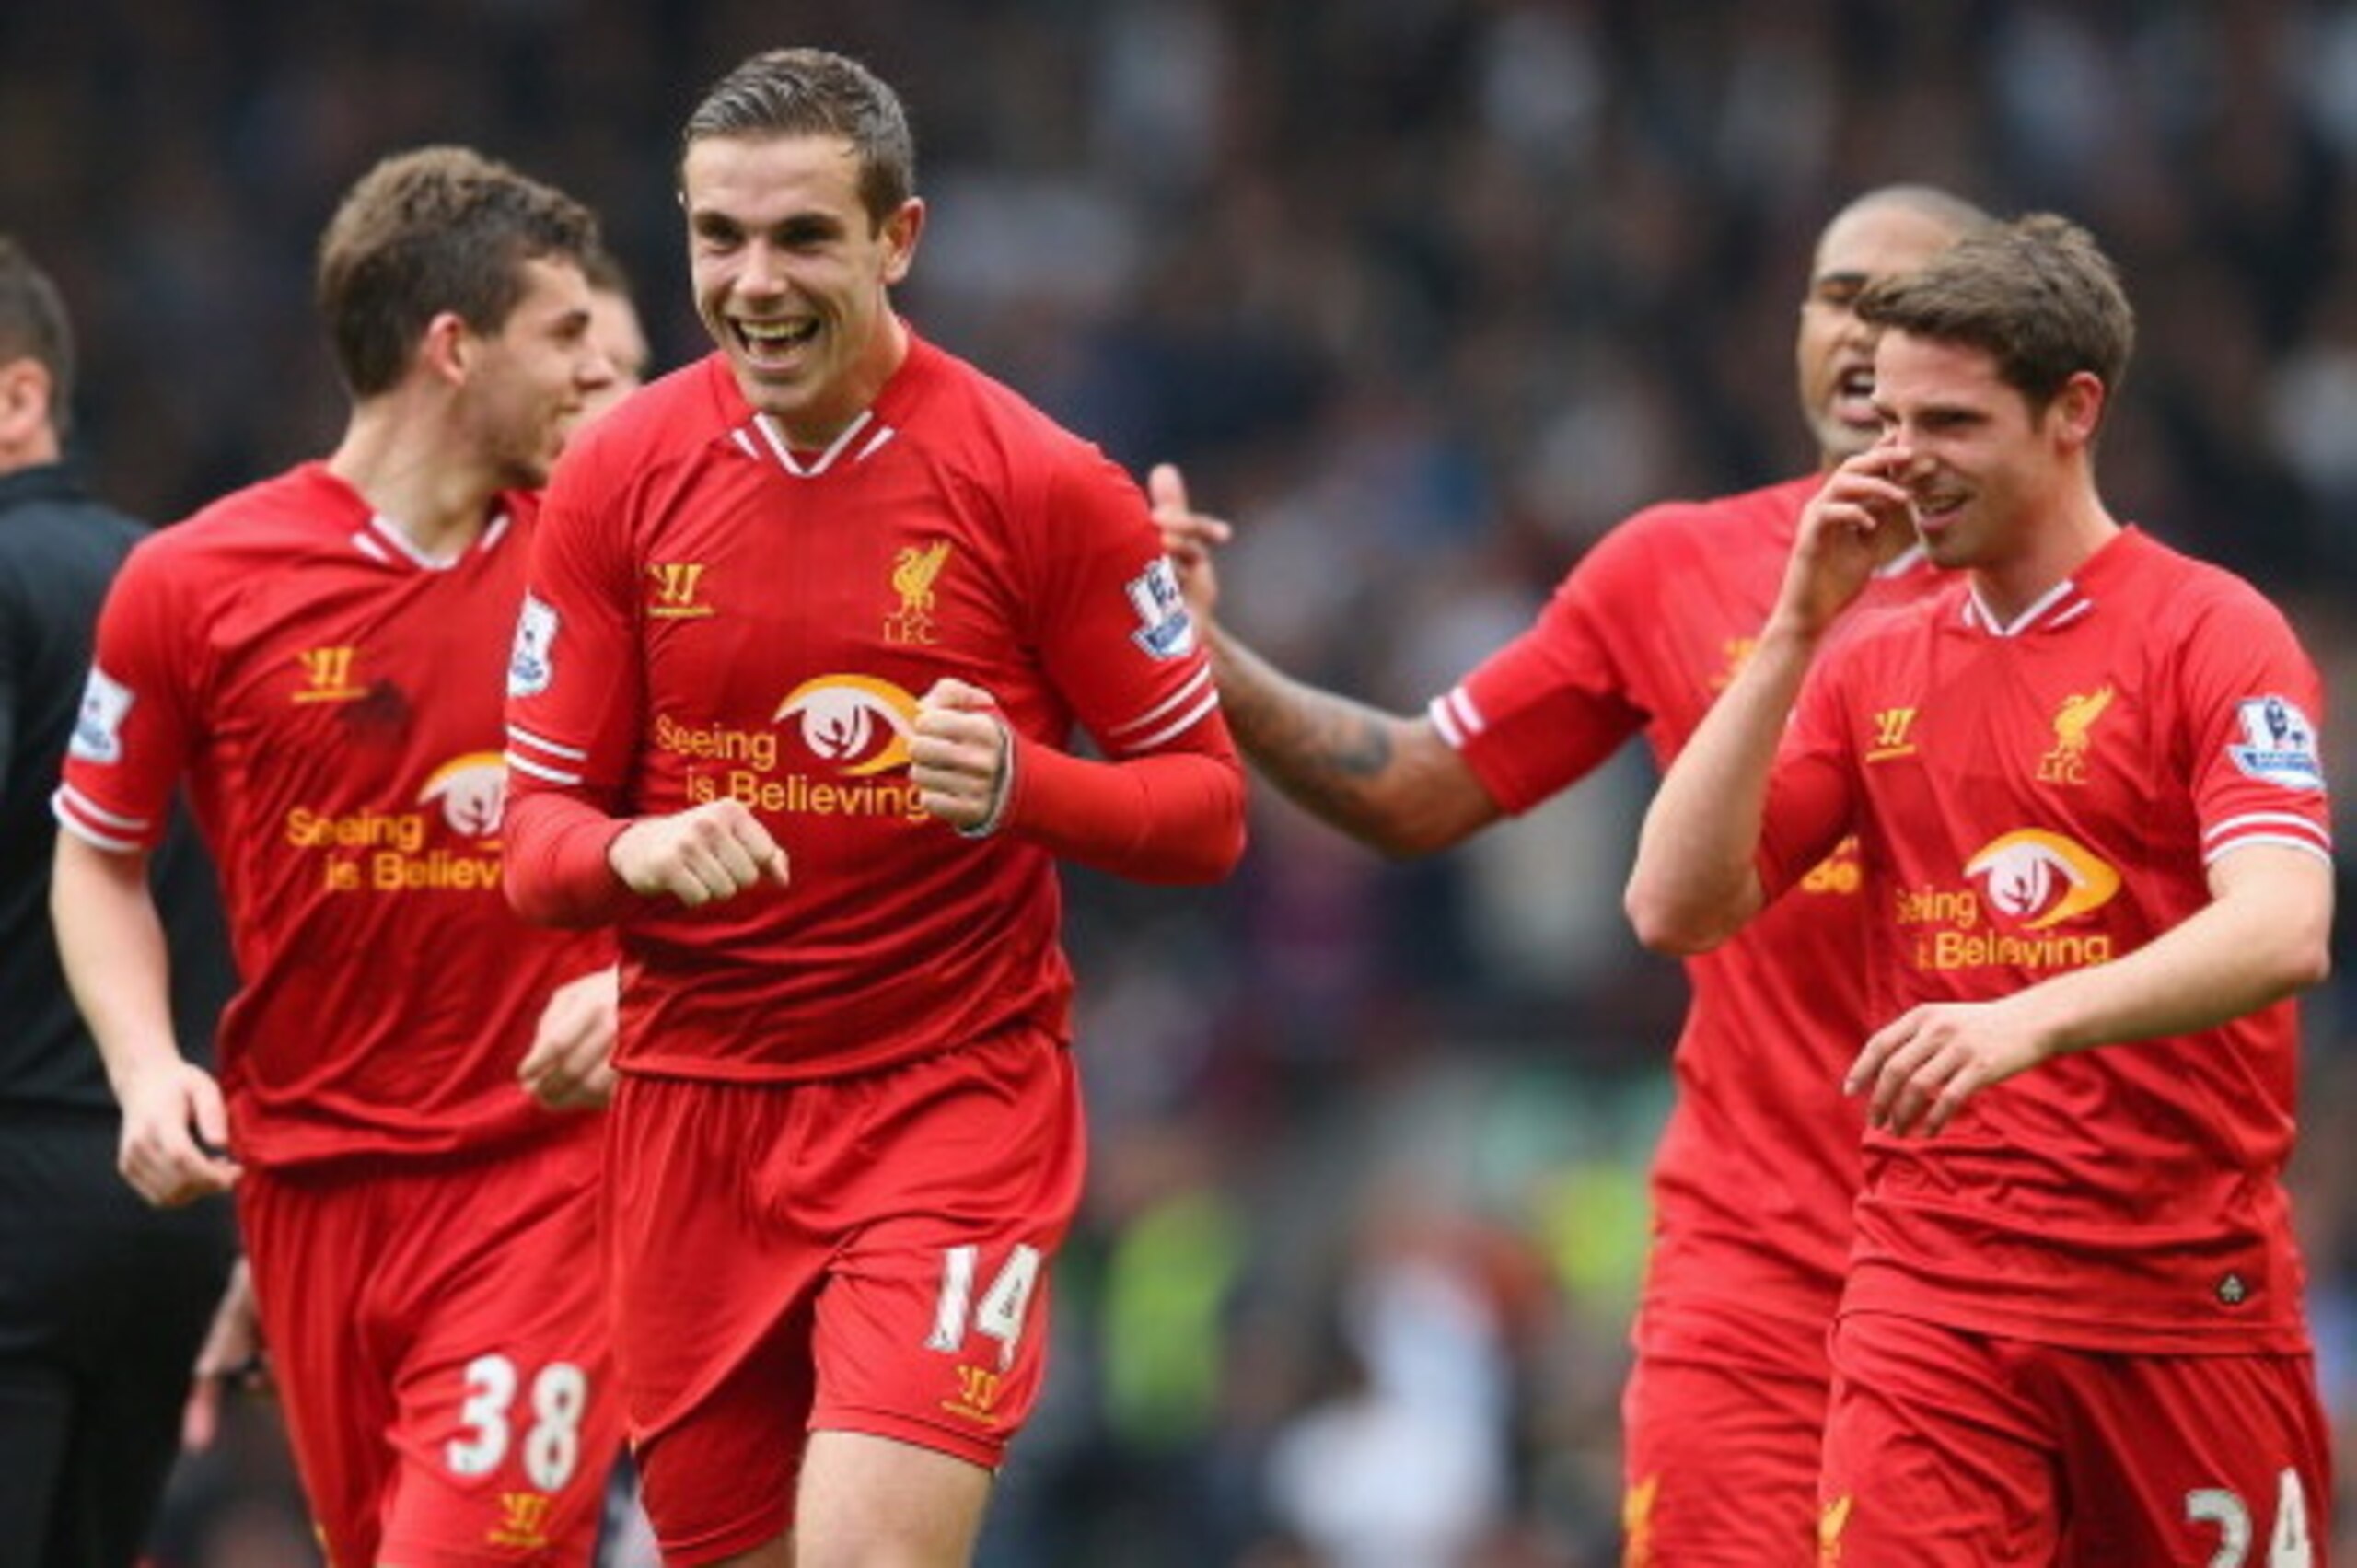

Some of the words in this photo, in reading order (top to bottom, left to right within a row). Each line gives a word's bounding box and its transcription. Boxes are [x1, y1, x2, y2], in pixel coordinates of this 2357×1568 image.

[656, 713, 777, 772] Seeing
[686, 766, 715, 802] is
[728, 770, 930, 822] Believing
[286, 808, 424, 853] Seeing
[326, 854, 360, 890] is
[924, 1244, 1041, 1368] 14
[447, 1353, 589, 1493] 38
[2185, 1467, 2314, 1568] 24
